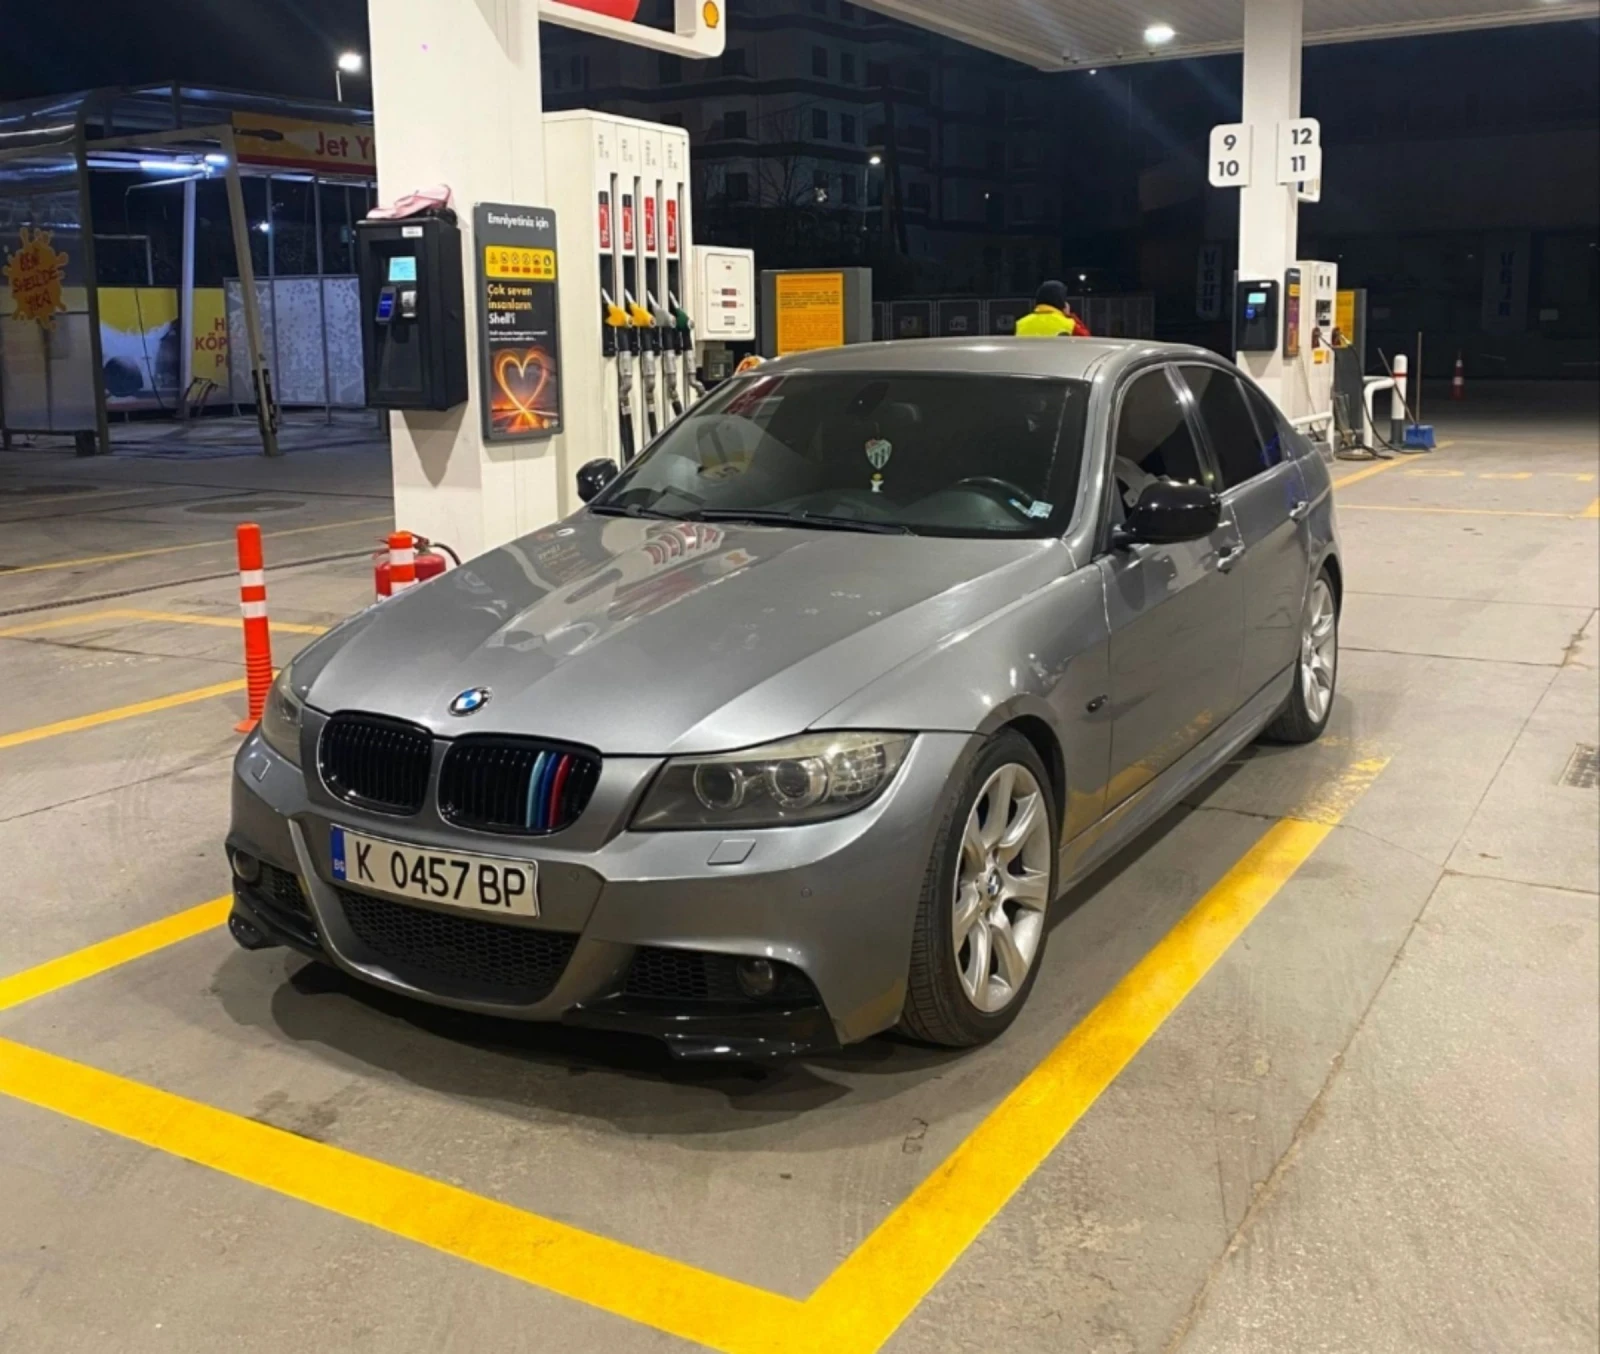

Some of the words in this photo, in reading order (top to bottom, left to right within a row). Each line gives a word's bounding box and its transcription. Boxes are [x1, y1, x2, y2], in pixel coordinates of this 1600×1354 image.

[315, 131, 349, 157] Jet
[1223, 134, 1237, 151] 9
[1291, 128, 1313, 145] 12
[1217, 160, 1239, 177] 10
[1290, 155, 1306, 172] 11
[487, 212, 534, 229] Emniyetiniz
[535, 216, 550, 231] için
[487, 283, 506, 298] Çok
[507, 286, 533, 297] seven
[488, 311, 517, 325] Shell'i
[333, 858, 346, 873] BG
[355, 841, 375, 884] K
[389, 850, 471, 900] 0457
[478, 863, 526, 908] BP
